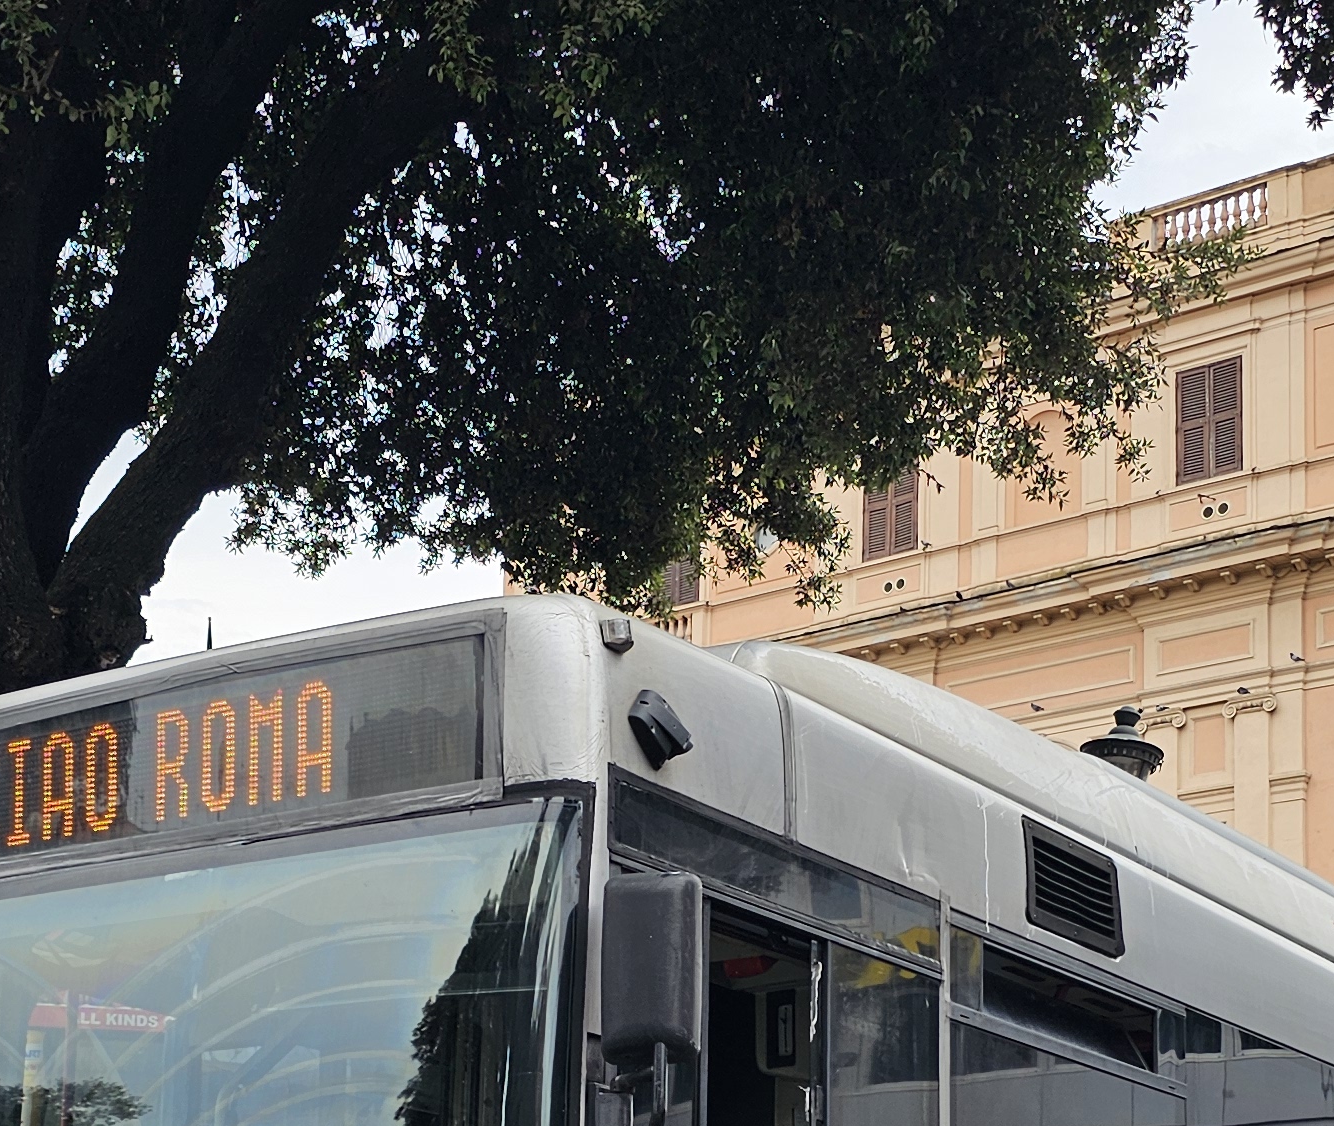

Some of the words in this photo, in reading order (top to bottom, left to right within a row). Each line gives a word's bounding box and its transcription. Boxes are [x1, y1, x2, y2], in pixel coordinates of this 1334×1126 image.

[156, 680, 332, 822] ROMA
[78, 1012, 101, 1025] LL
[106, 1013, 158, 1028] KINDS
